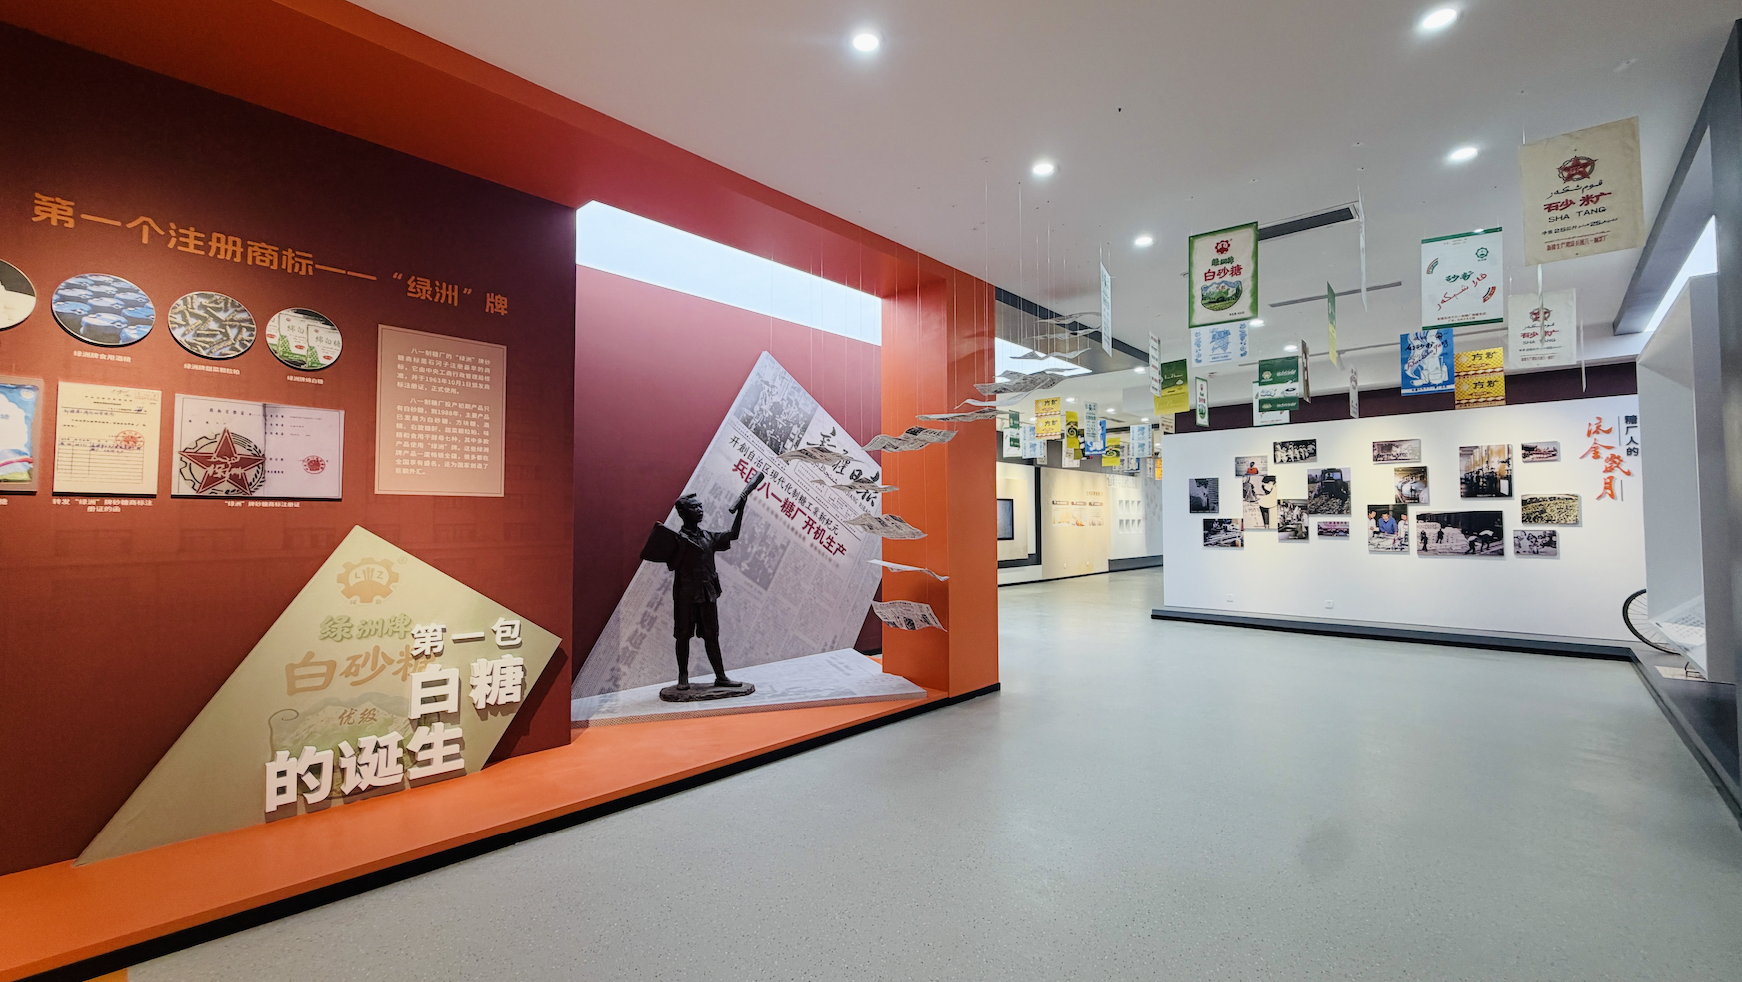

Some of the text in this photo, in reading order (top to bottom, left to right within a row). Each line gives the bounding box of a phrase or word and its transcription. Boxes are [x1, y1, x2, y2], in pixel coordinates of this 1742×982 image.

[1548, 213, 1570, 223] SHA
[1576, 206, 1607, 217] TANG
[1204, 264, 1243, 282] 白砂糖
[1624, 415, 1639, 456] 糖厂人的
[319, 613, 412, 641] 绿洲牌
[411, 617, 523, 658] 第一包
[408, 653, 524, 719] 白糖
[338, 707, 378, 726] 优级
[265, 721, 466, 813] 的诞生
